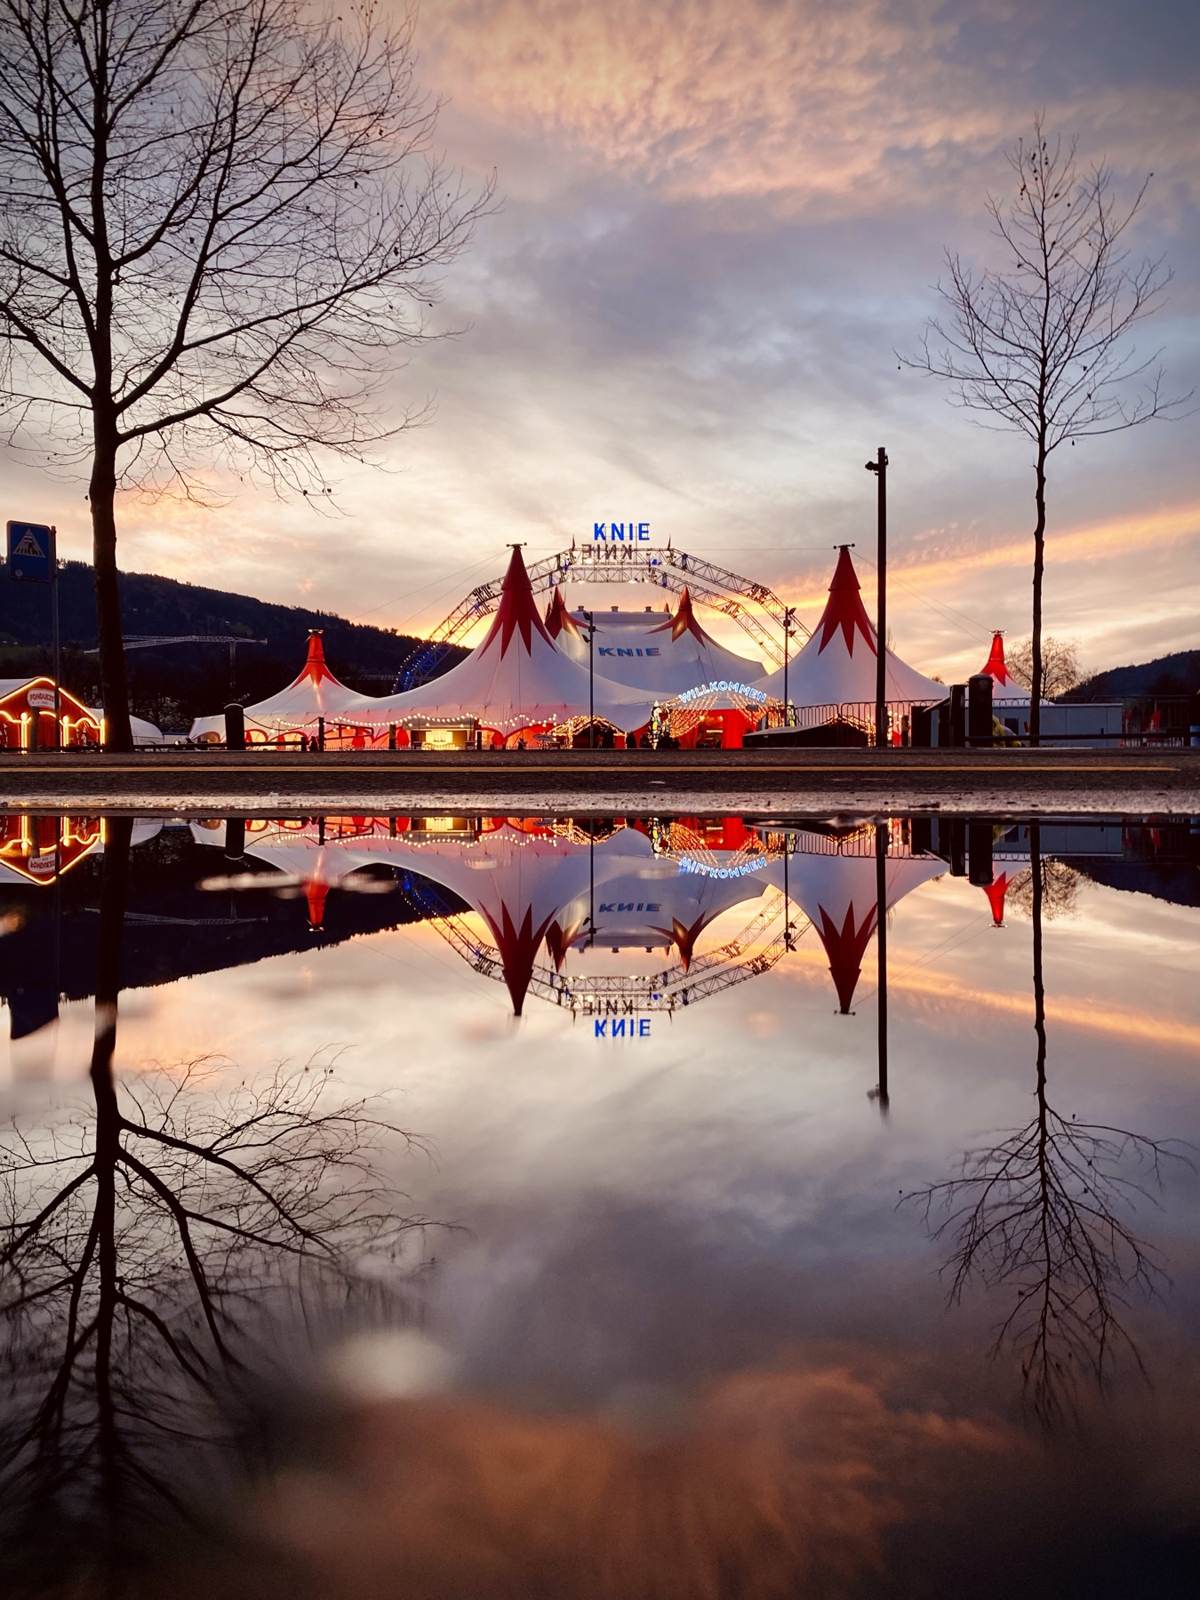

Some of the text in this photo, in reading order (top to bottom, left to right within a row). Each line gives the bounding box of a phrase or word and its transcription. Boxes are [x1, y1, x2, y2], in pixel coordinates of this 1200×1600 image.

[594, 523, 650, 541] KNIE
[598, 647, 661, 656] KNIE
[680, 681, 766, 703] WILLKOMMEN
